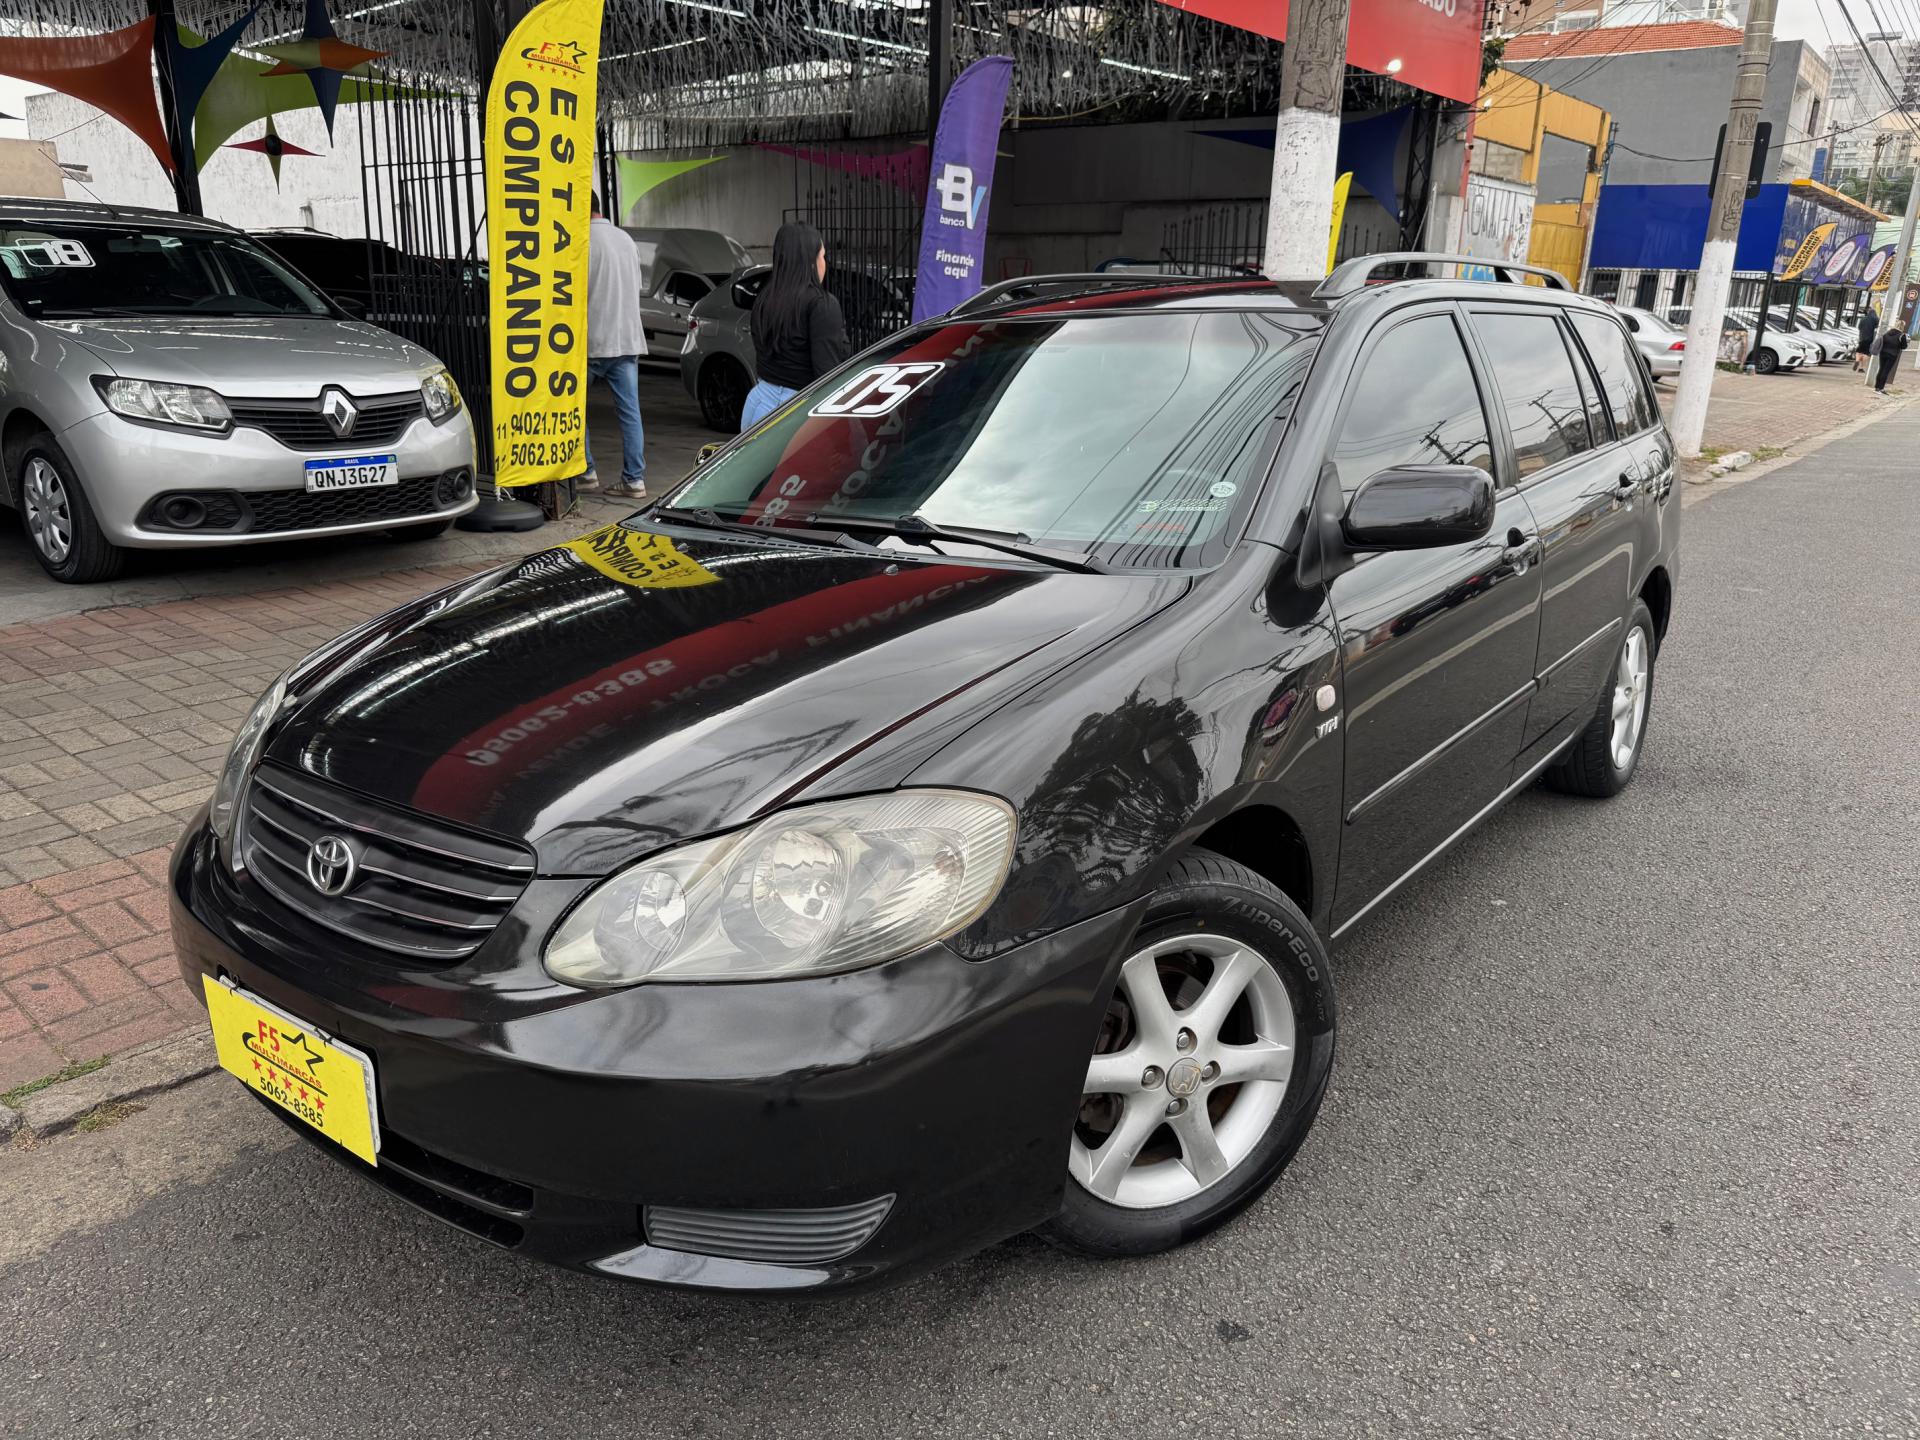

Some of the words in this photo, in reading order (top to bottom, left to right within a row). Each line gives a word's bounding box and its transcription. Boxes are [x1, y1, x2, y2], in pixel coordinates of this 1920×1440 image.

[531, 53, 581, 71] MULTIMARCAS
[540, 42, 564, 60] F5
[939, 214, 965, 227] banco
[504, 80, 541, 398] COMPRANDO
[548, 87, 578, 397] ESTAMOS
[41, 242, 91, 265] 18
[944, 266, 968, 280] aqui
[817, 366, 936, 413] 05
[497, 423, 507, 440] 11
[315, 465, 386, 488] QNJ3G27
[1222, 896, 1320, 982] ZuperEco
[257, 1019, 281, 1052] F5
[251, 1041, 323, 1089] MULTIMARCAS
[260, 1077, 324, 1128] 5062-8385
